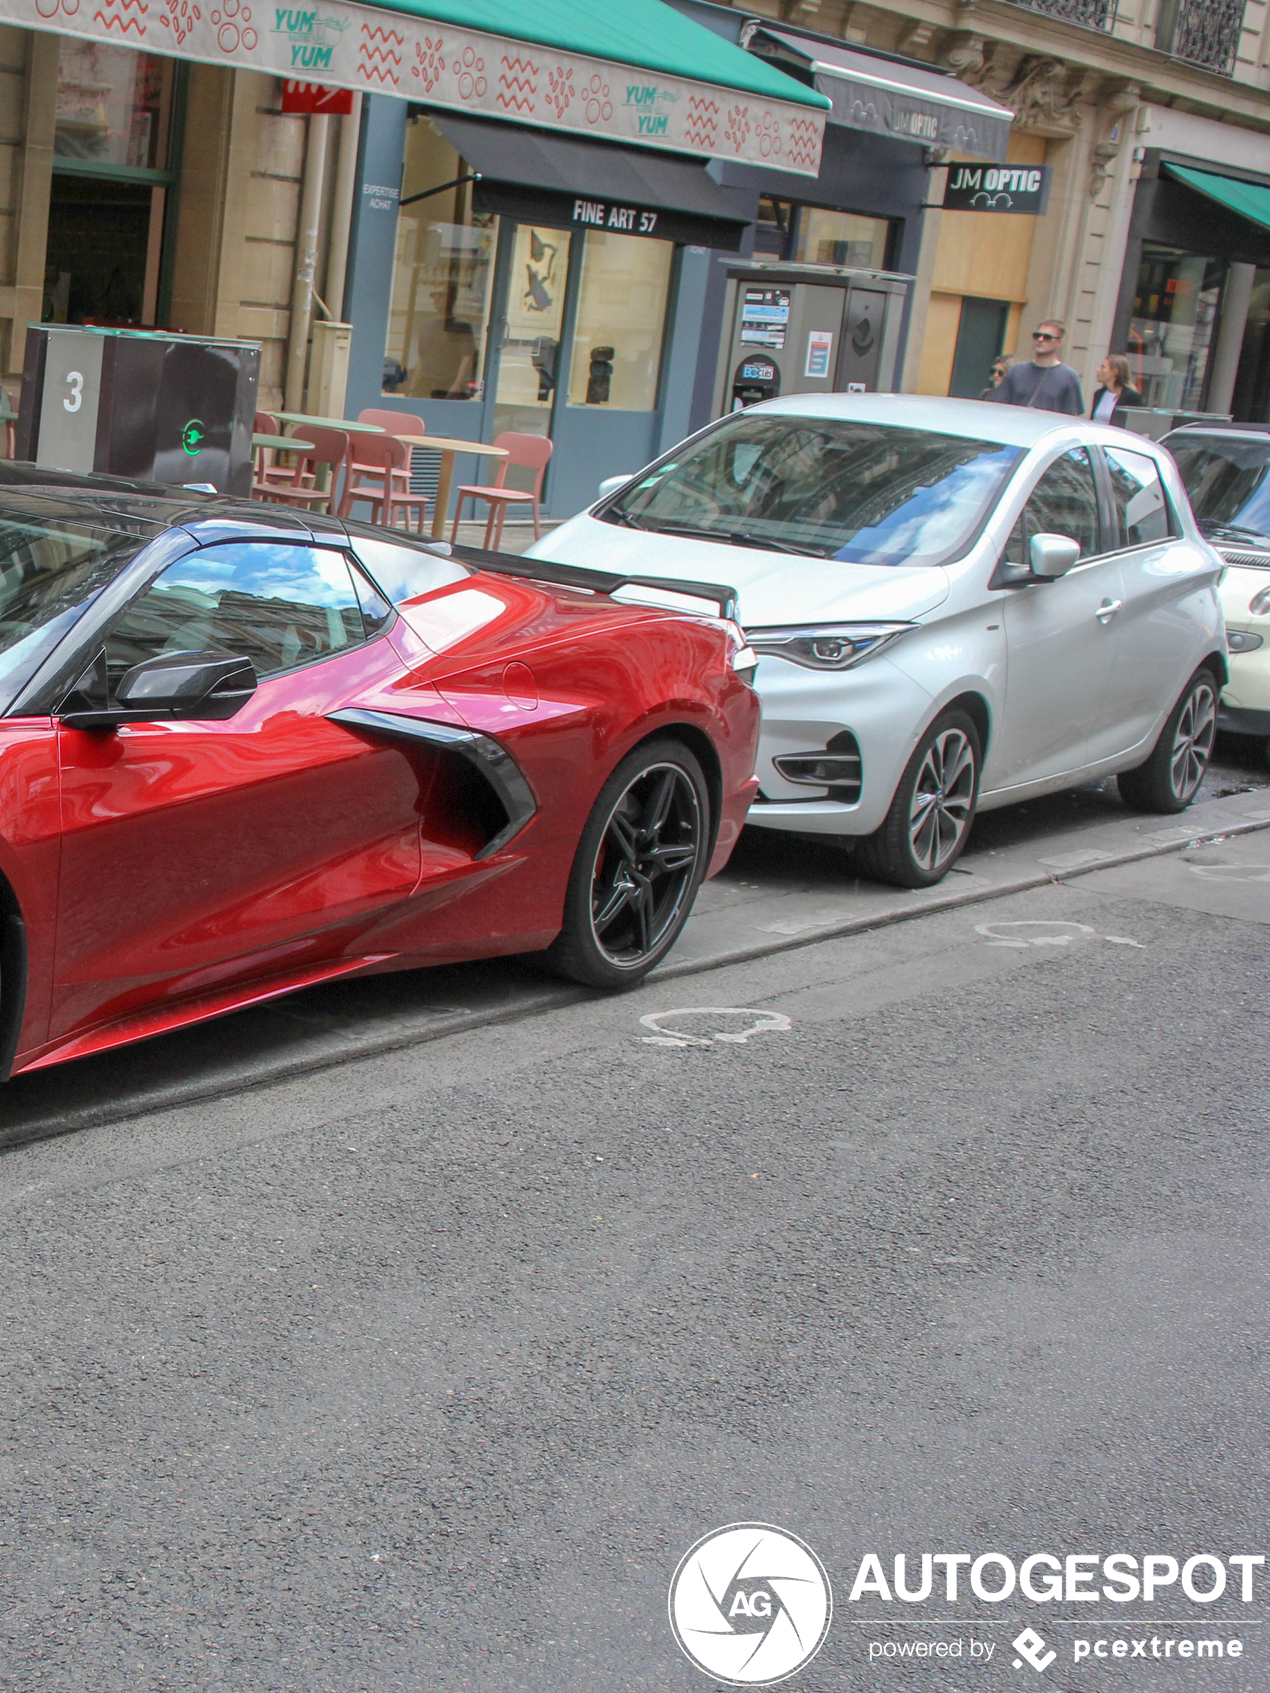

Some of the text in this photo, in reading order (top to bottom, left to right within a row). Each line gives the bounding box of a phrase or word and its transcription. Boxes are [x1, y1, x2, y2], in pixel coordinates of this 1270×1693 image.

[275, 8, 317, 32] YUM
[290, 45, 333, 68] YUM
[626, 85, 658, 104] YUM
[638, 115, 669, 134] YUM
[911, 112, 938, 138] OPTIC
[363, 184, 400, 198] EXPERTISE
[950, 168, 1042, 192] JM OPTIC
[369, 198, 392, 210] ACHAT
[573, 199, 658, 232] FINE ART 57
[63, 371, 84, 413] 3
